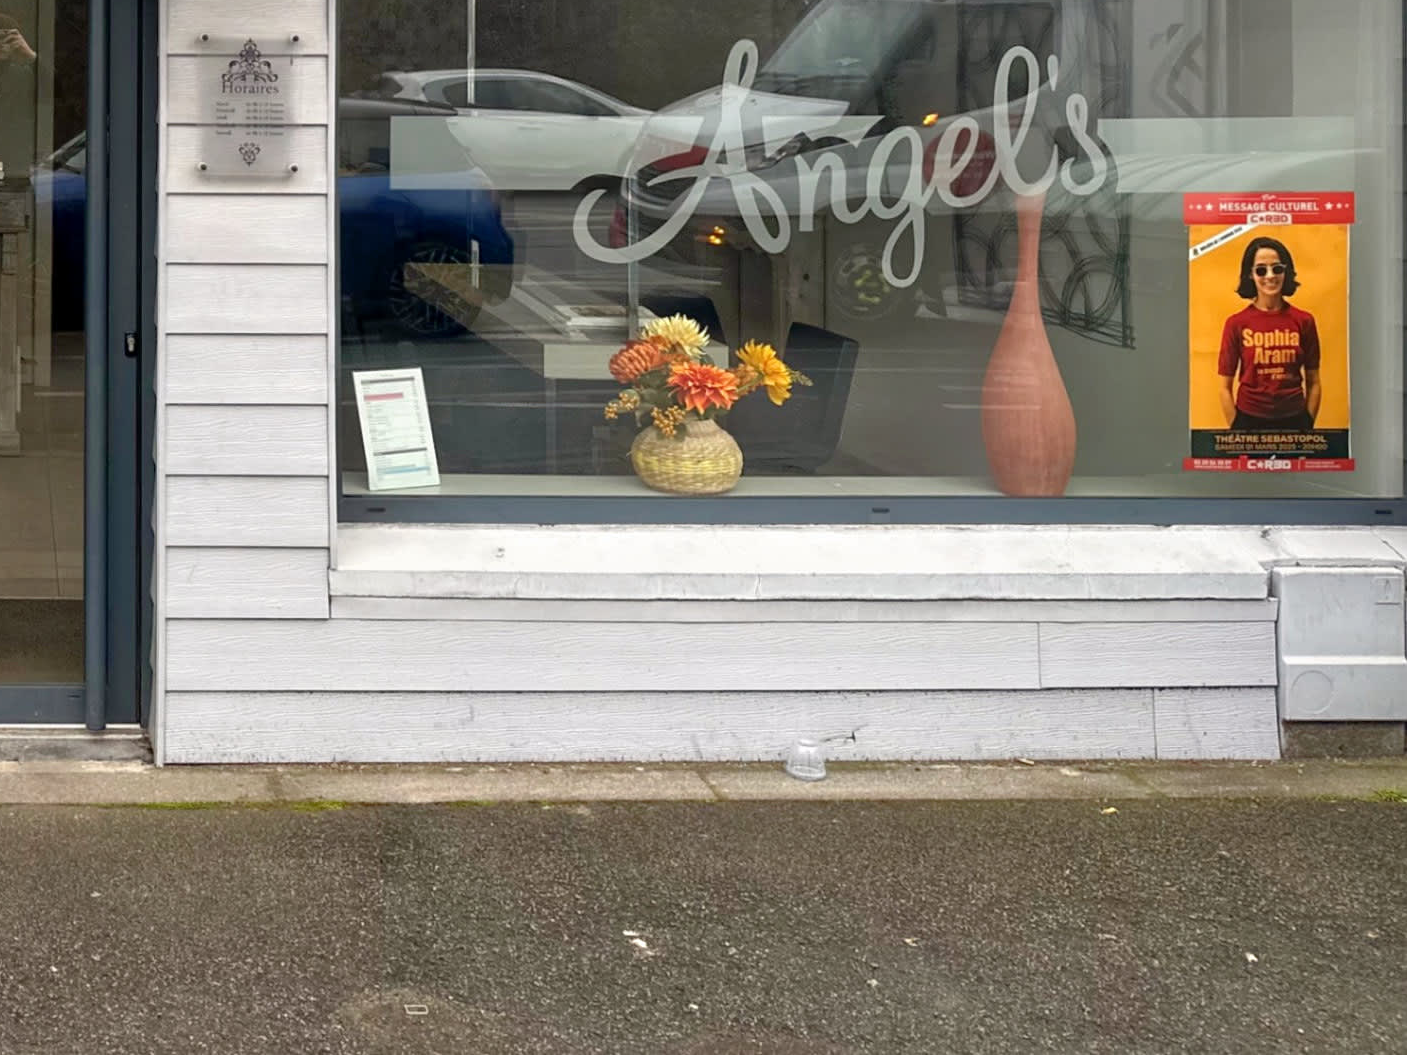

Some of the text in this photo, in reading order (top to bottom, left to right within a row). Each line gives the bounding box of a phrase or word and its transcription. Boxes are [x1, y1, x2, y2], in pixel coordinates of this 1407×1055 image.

[221, 79, 280, 94] Horaires
[573, 38, 1112, 288] Angel's
[1219, 201, 1319, 212] MESSAGE CULTUREL
[1242, 328, 1299, 348] Sophia
[1254, 347, 1296, 364] Aram
[1261, 434, 1327, 443] SEBASTOPOL
